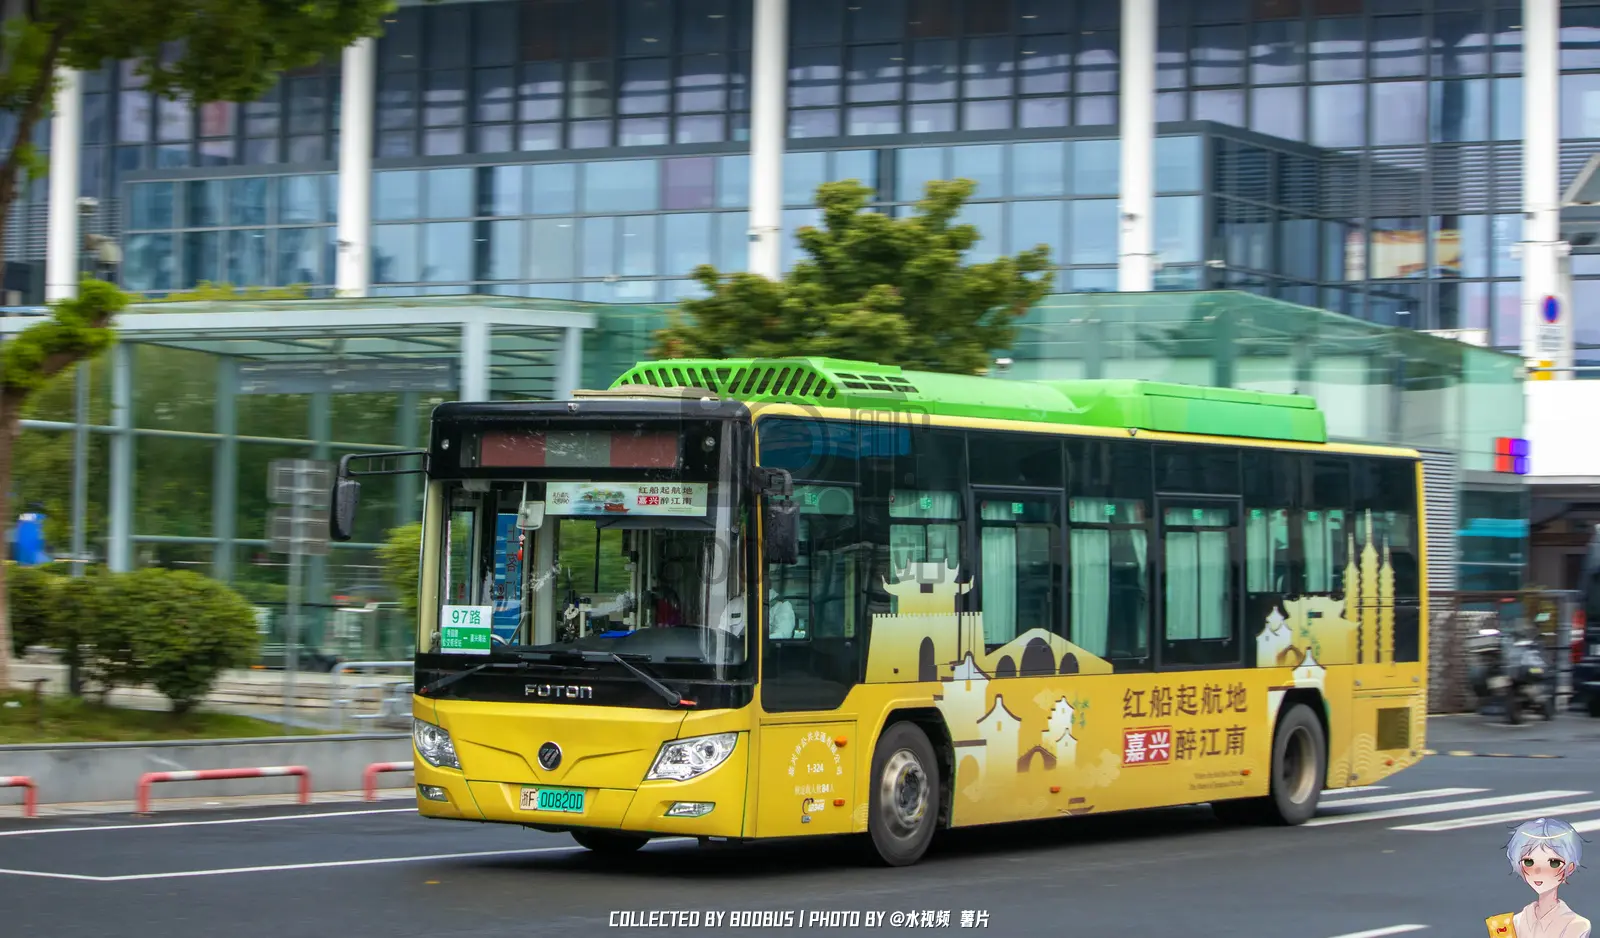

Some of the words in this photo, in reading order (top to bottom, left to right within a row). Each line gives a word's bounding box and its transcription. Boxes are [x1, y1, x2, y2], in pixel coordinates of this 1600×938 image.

[638, 486, 693, 495] 红船起航地
[452, 609, 481, 625] 97路
[525, 684, 592, 698] FOTON
[1122, 682, 1248, 719] 红船起航地
[1124, 724, 1247, 764] 嘉兴醉江南
[806, 763, 824, 773] 1-324
